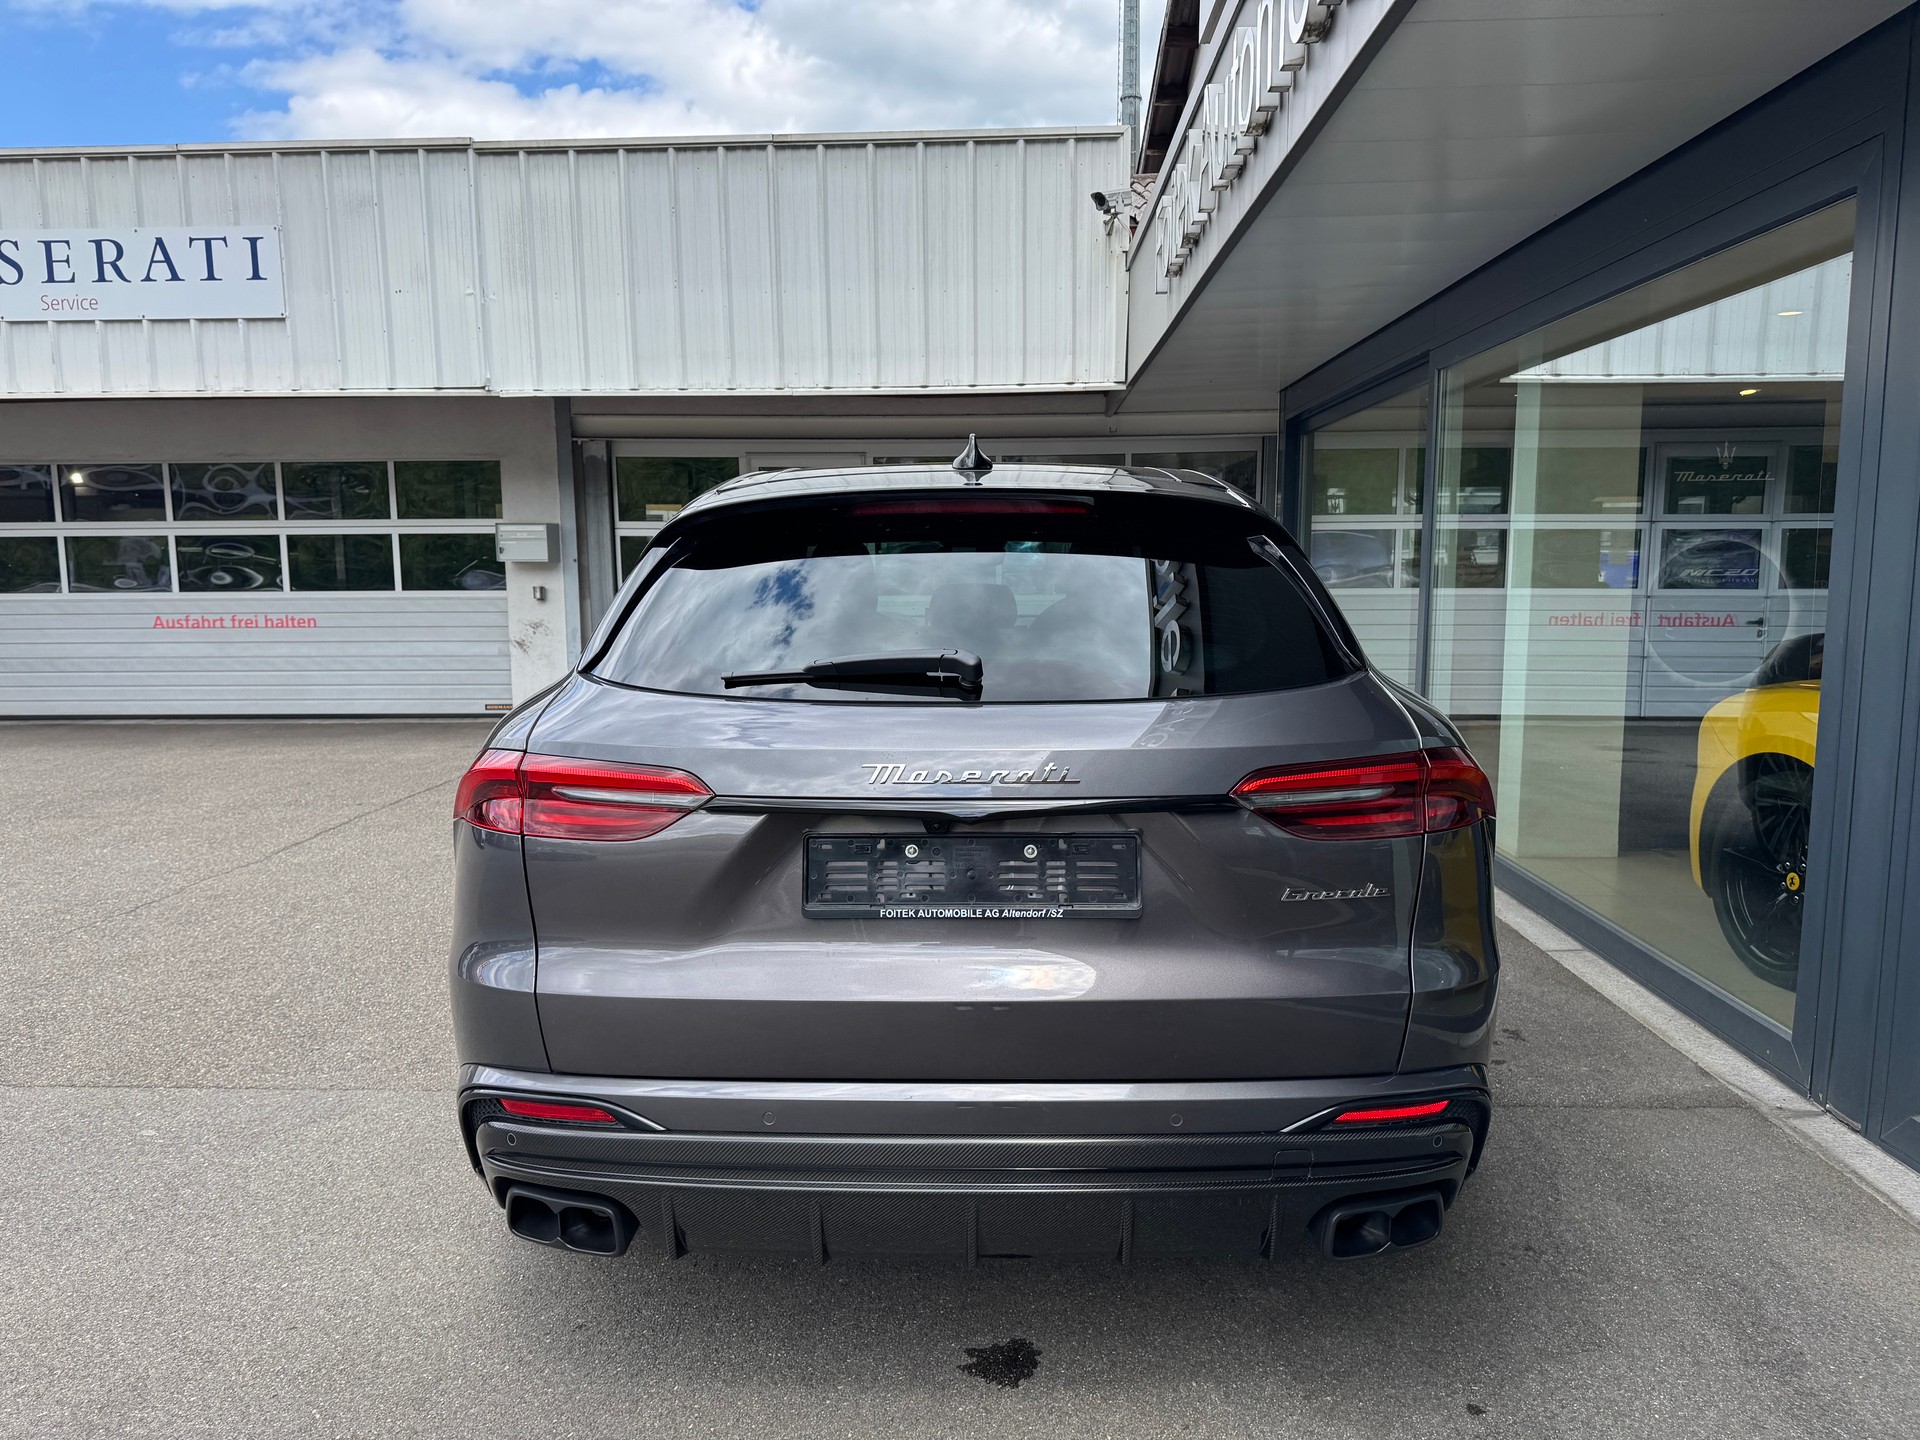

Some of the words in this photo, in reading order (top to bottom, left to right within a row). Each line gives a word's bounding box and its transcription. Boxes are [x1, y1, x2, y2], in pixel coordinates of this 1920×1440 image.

[0, 236, 268, 286] SERATI
[40, 294, 99, 312] Service
[1674, 470, 1775, 482] Maserati
[1679, 568, 1760, 577] MC20
[153, 614, 226, 630] Ausfahrt
[230, 614, 260, 629] frei
[264, 614, 318, 629] halten
[861, 762, 1081, 785] Maserati
[1281, 882, 1391, 902] Grecale
[880, 909, 916, 918] FOITEK
[917, 909, 983, 918] AUTOMOBILE
[984, 909, 1000, 918] AG
[1002, 909, 1047, 918] Altendorf
[1047, 909, 1064, 918] /SZ
